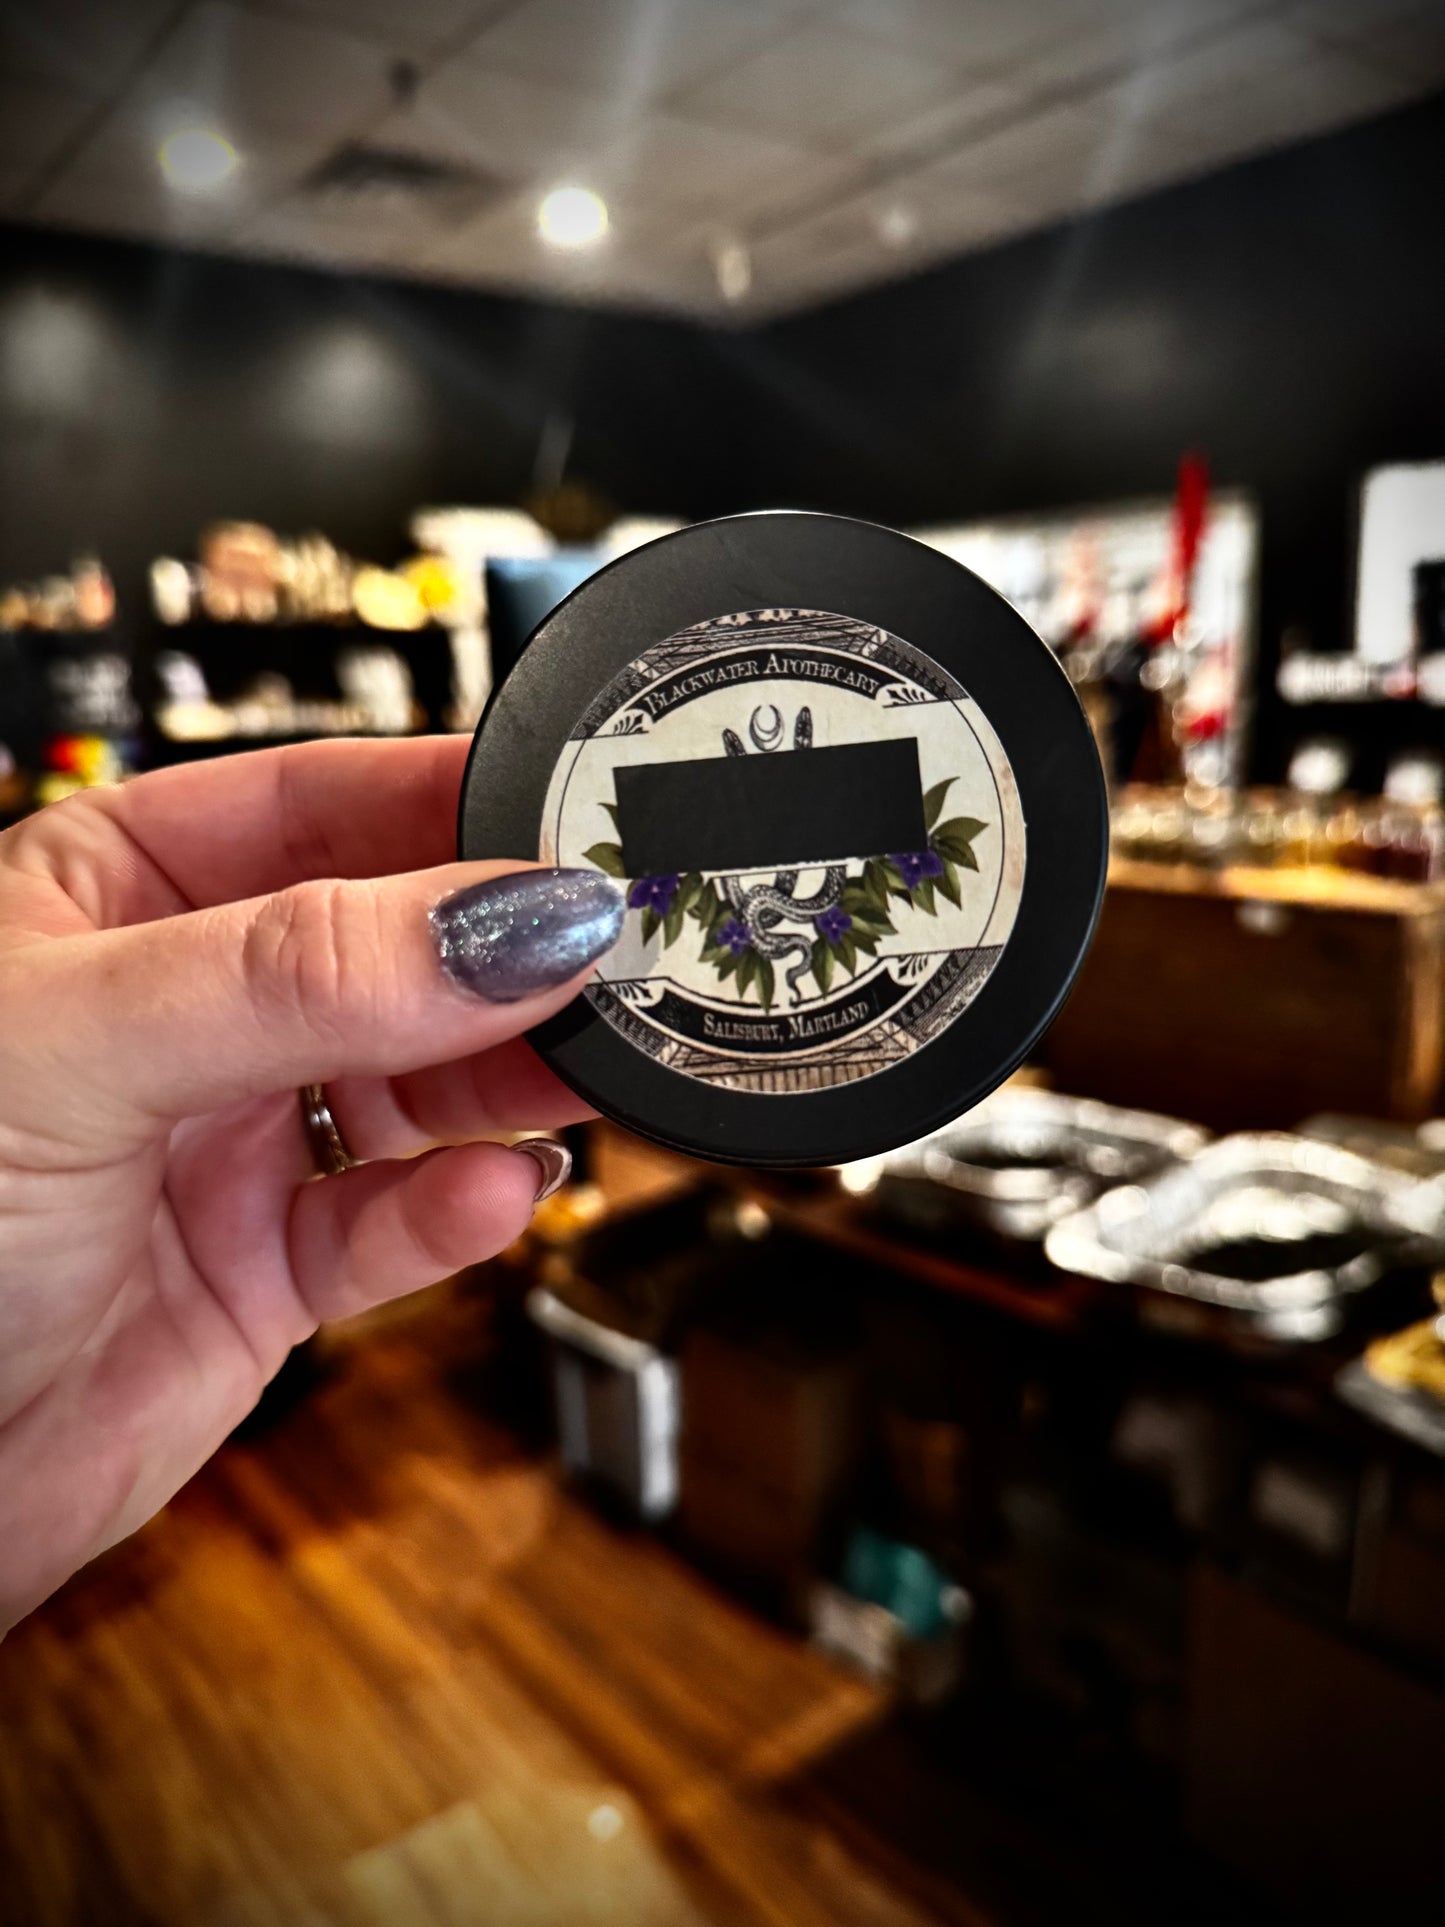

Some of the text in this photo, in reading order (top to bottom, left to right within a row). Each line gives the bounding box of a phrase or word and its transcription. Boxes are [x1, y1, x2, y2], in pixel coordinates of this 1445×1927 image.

[646, 653, 880, 714] BLACKWATER APOTHECARY
[703, 1001, 869, 1042] SALISBURY, MARYLAND
